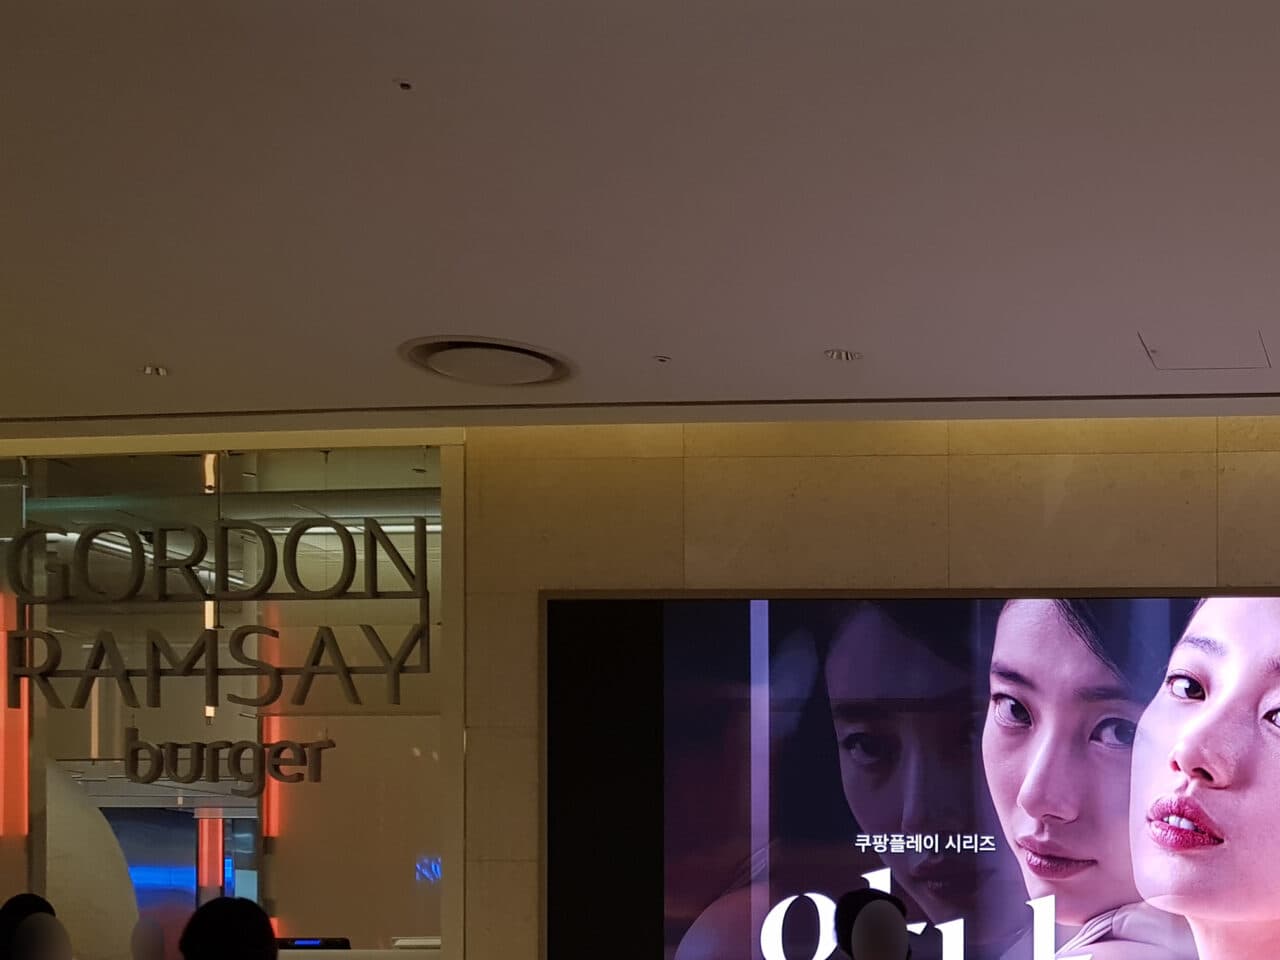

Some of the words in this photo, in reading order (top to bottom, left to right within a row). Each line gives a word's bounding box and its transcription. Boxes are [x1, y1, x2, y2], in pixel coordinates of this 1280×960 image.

[5, 516, 428, 601] GORDON
[7, 623, 430, 709] RAMSAY
[125, 727, 336, 798] burger
[855, 834, 939, 853] 쿠팡플레이
[945, 834, 996, 853] 시리즈
